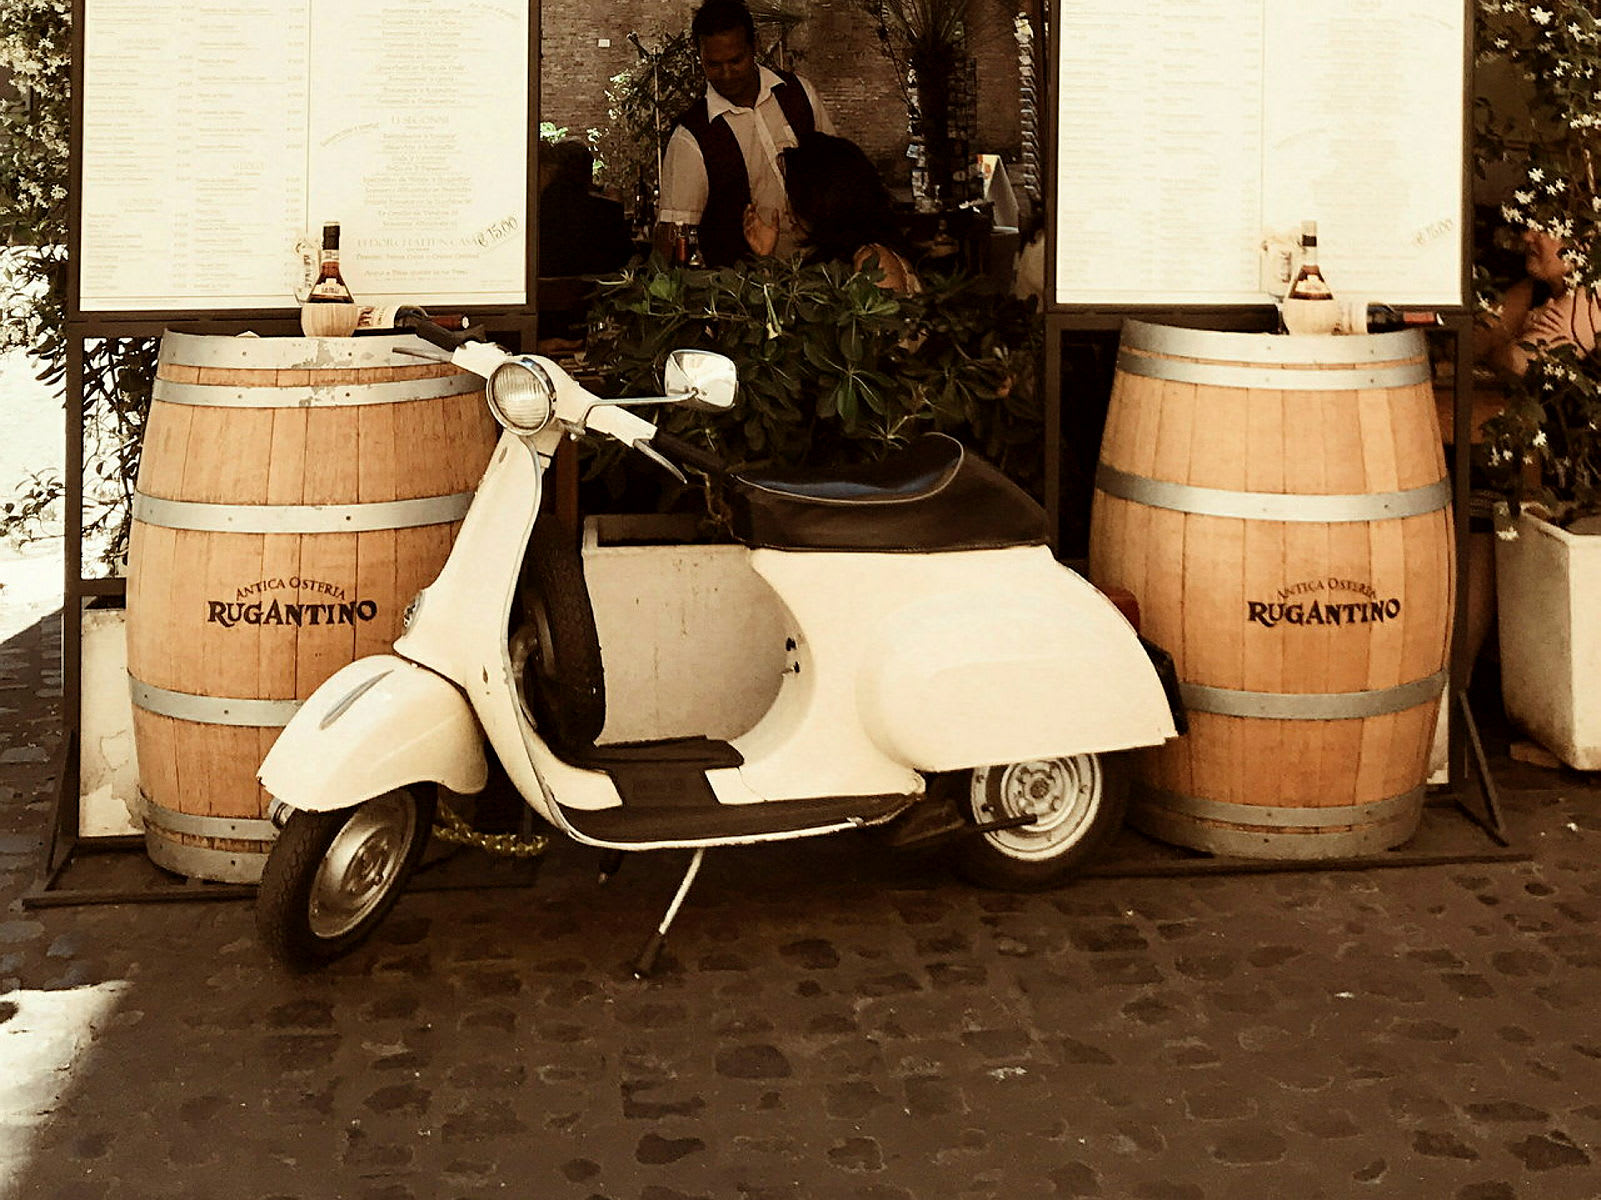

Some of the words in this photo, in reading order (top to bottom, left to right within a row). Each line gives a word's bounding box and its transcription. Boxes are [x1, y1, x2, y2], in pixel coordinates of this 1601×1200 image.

[236, 577, 286, 601] ANTICA
[289, 576, 345, 601] OSTERIA
[1276, 579, 1325, 601] ANTICA
[207, 598, 378, 628] RUGANTINO
[1247, 598, 1401, 628] RUGANTINO
